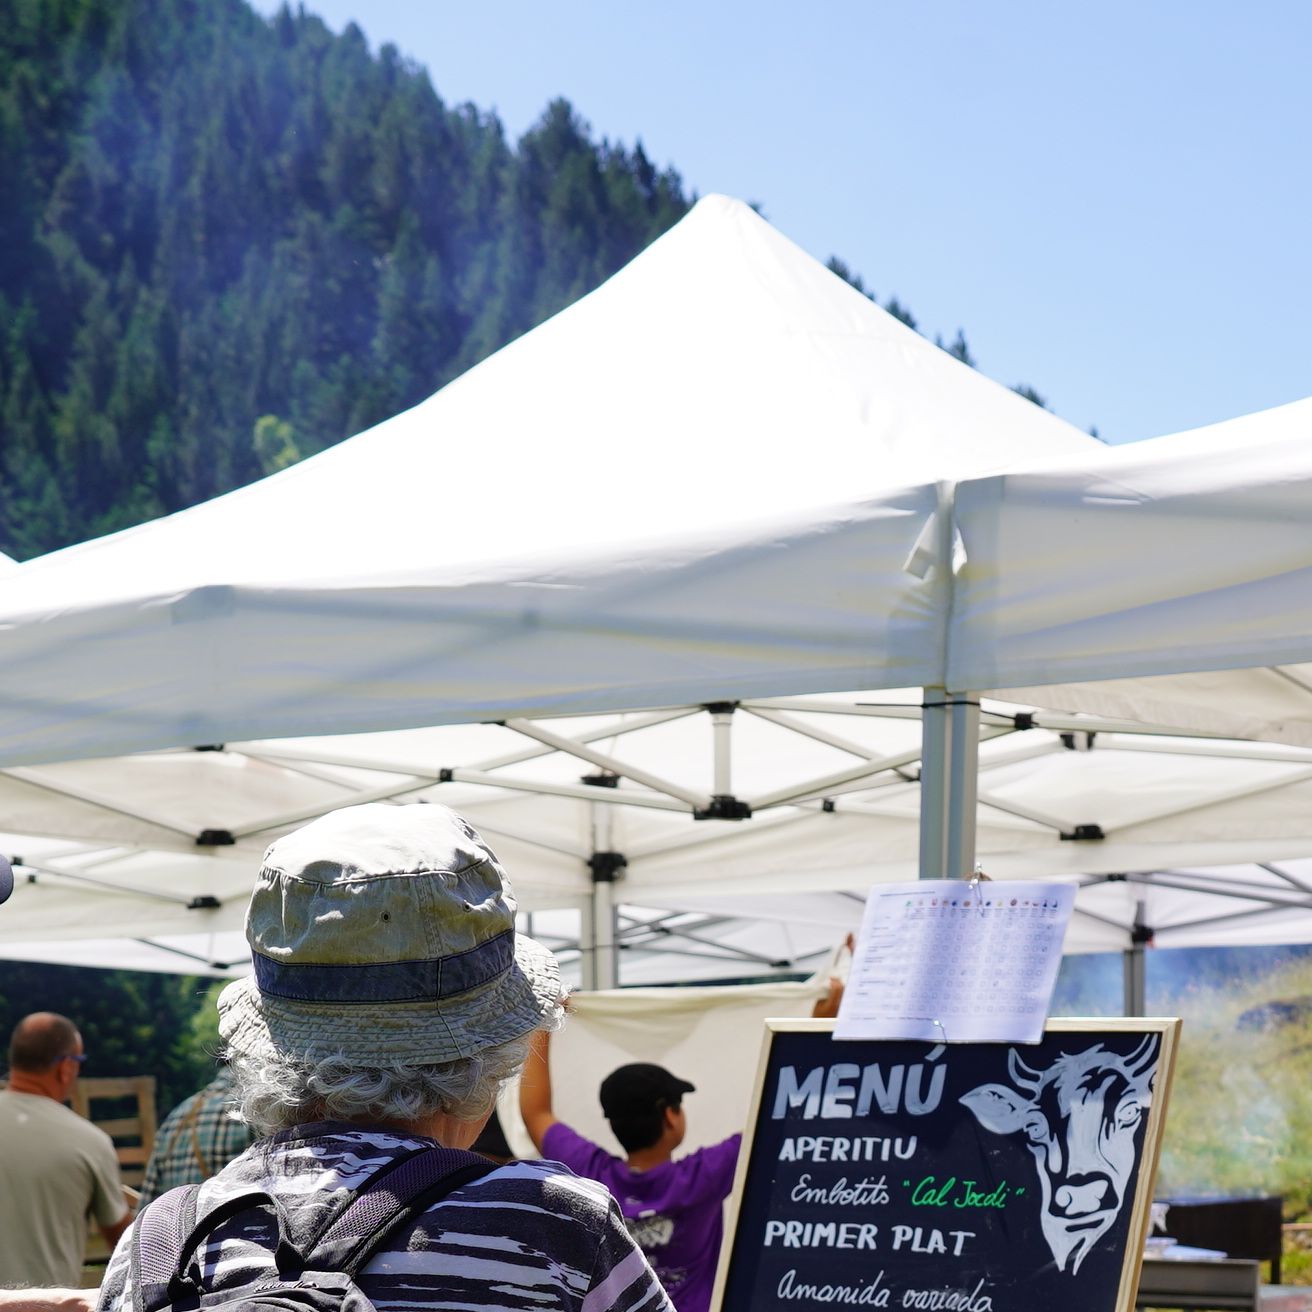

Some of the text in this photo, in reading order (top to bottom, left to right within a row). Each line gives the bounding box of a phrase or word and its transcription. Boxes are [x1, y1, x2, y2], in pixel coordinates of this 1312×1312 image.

[772, 1044, 947, 1120] MENÚ
[779, 1136, 917, 1162] APERITIU
[791, 1174, 889, 1205] Embotits
[763, 1220, 977, 1256] PRIMER PLAT
[777, 1269, 993, 1312] Amanida variada
